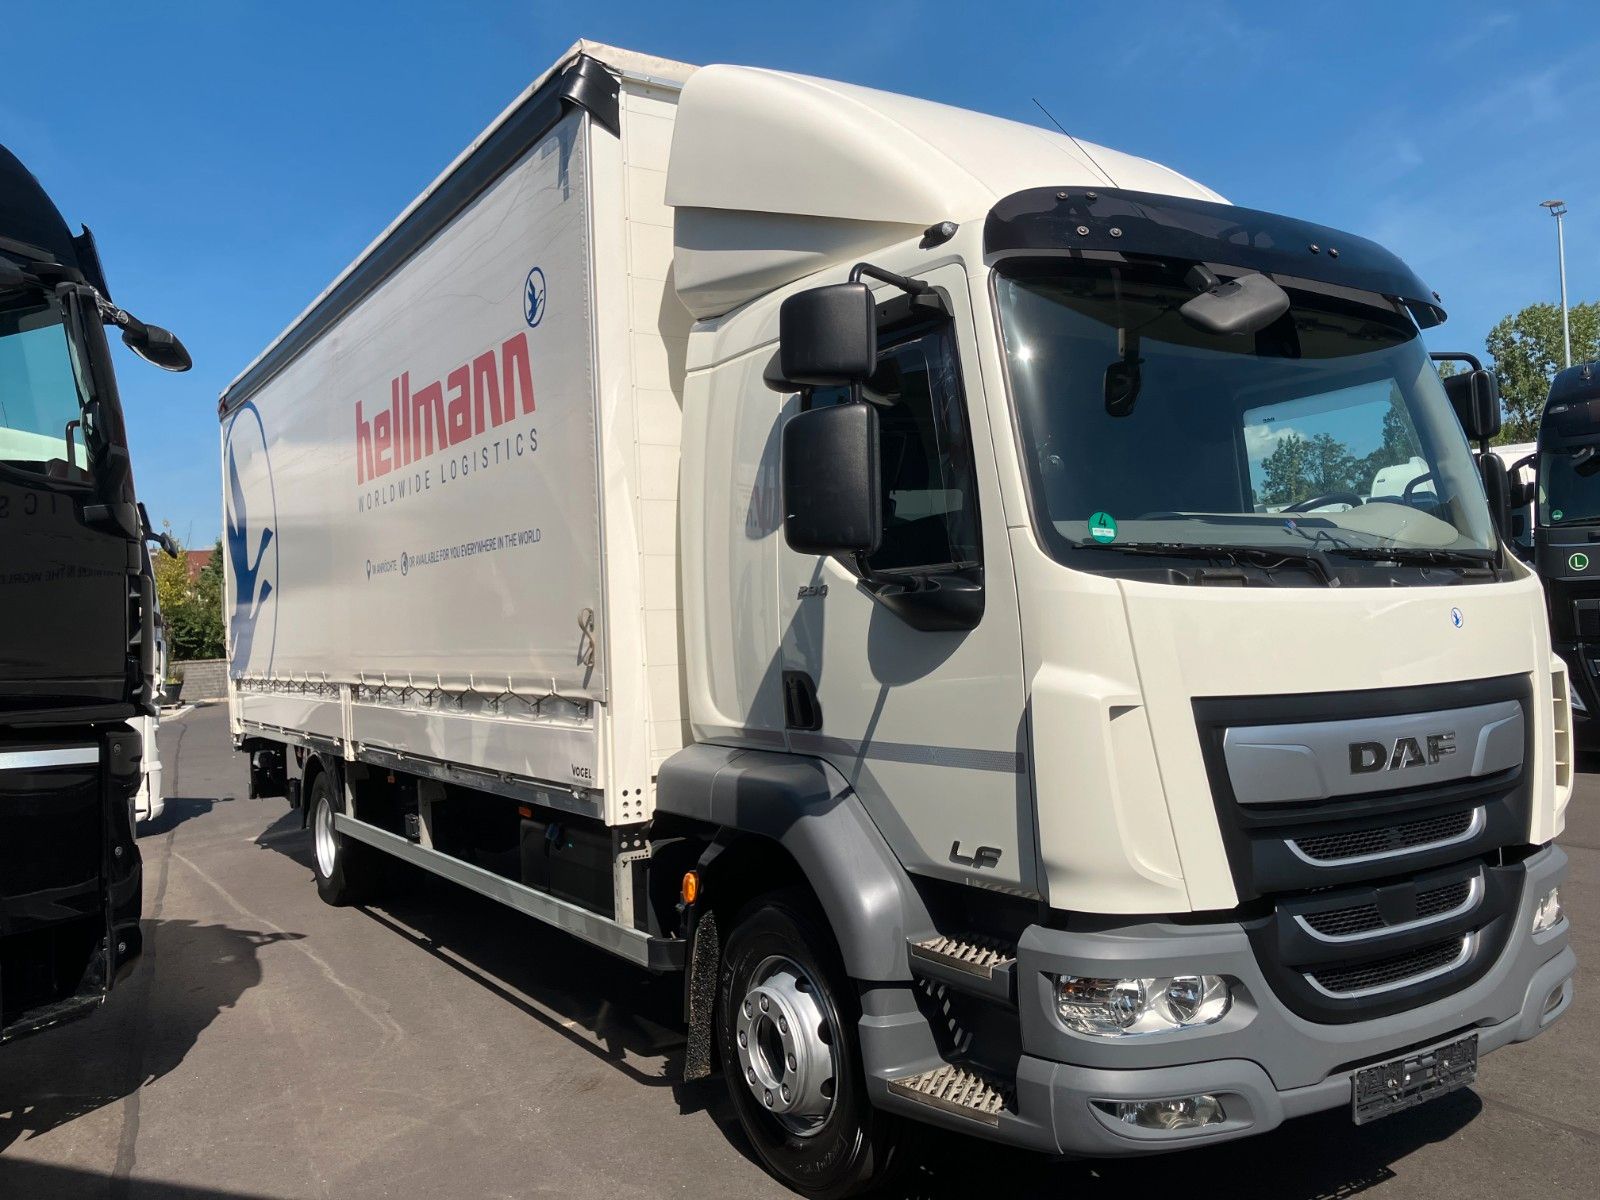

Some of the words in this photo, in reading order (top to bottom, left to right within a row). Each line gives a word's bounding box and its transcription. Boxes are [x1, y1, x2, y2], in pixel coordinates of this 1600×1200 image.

[355, 332, 536, 486] hellmann
[358, 470, 431, 513] WORLDWIDE
[441, 428, 538, 484] LOGISTICS
[1098, 513, 1107, 528] 4
[416, 550, 440, 567] AVAILABLE
[440, 548, 450, 561] FOR
[450, 546, 461, 559] YOU
[461, 537, 497, 557] EVERYWHERE
[504, 532, 518, 548] THE
[518, 528, 541, 547] WORLD
[1574, 556, 1584, 567] L
[1348, 731, 1457, 775] DAF
[571, 763, 592, 779] VOGEL
[949, 840, 1003, 869] LF
